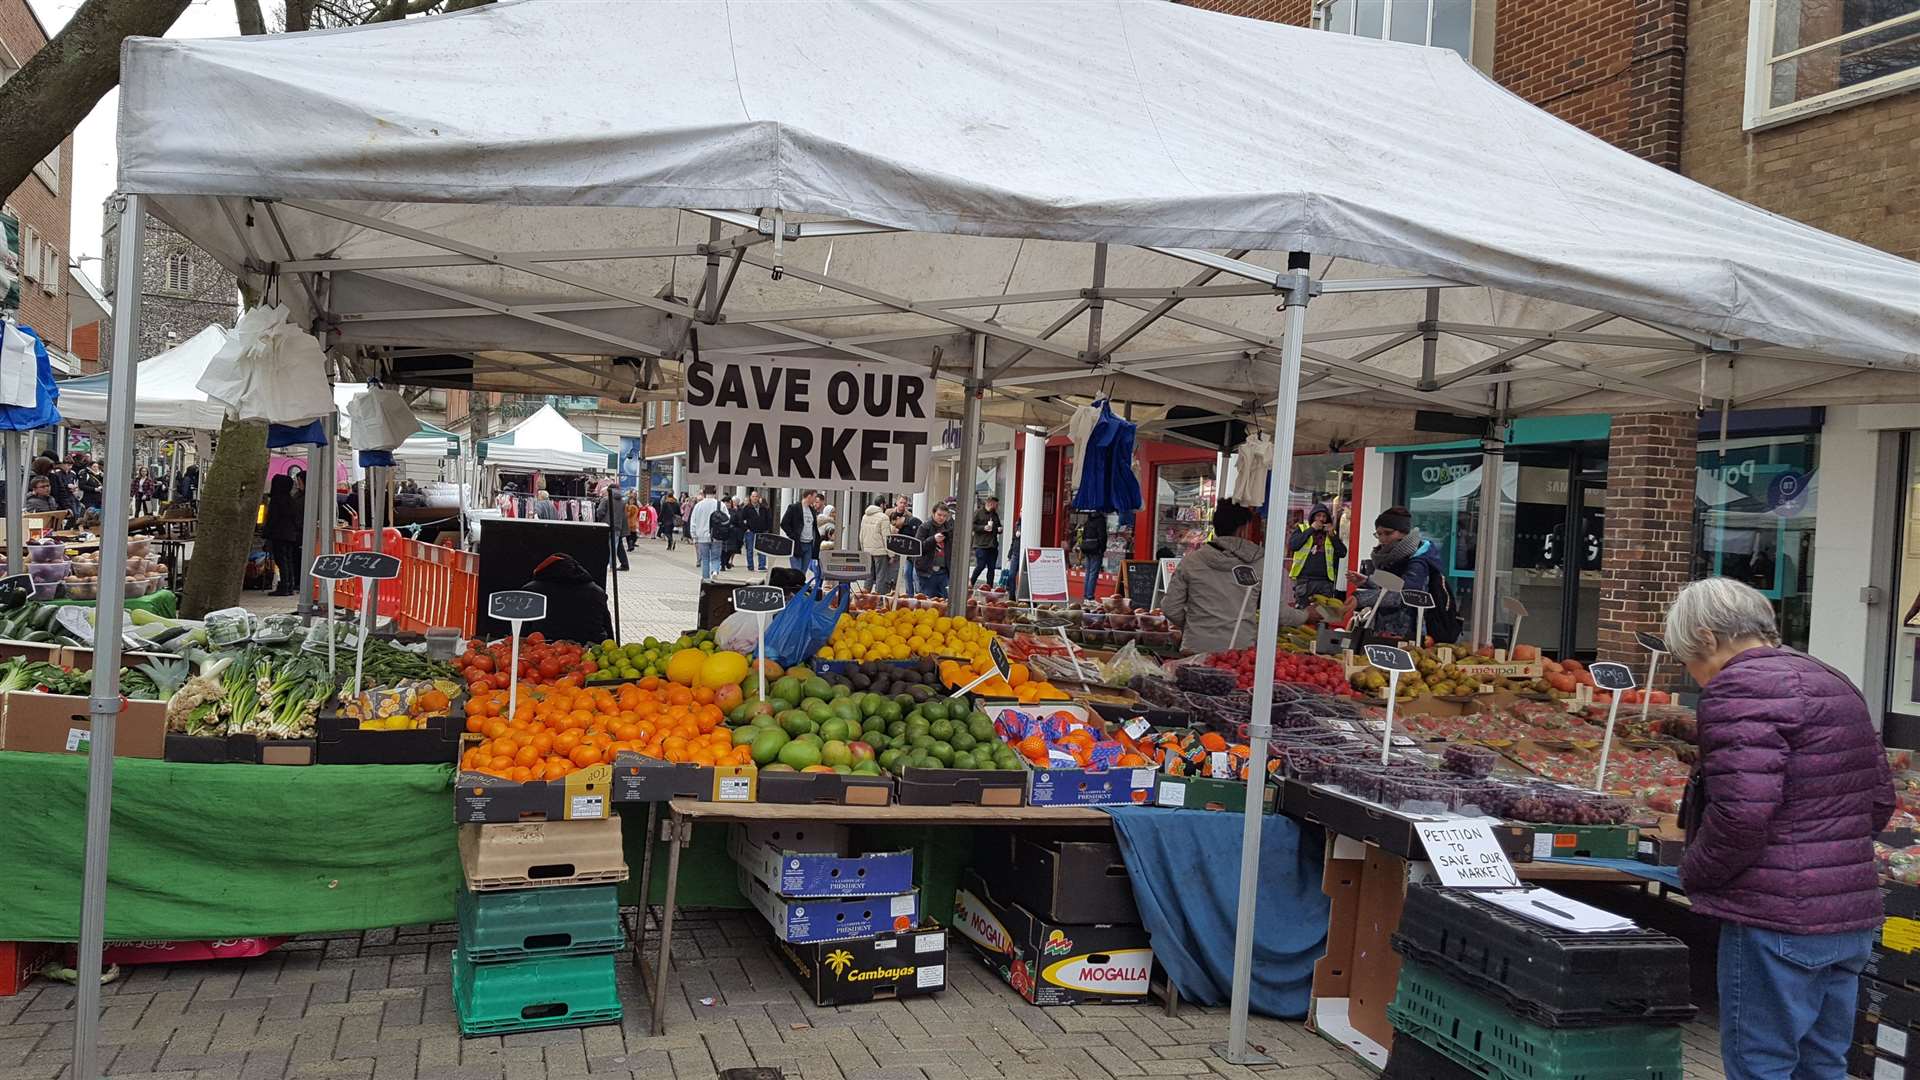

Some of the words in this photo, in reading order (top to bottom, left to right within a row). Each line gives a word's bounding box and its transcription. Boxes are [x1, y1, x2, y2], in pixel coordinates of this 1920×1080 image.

[687, 362, 811, 413] SAVE
[827, 372, 926, 418] OUR
[687, 419, 928, 484] MARKET
[1783, 481, 1794, 489] BT
[495, 596, 506, 612] 5
[1423, 827, 1483, 842] PETITION
[1448, 843, 1465, 852] TO
[1439, 854, 1472, 867] SAVE
[1479, 852, 1503, 864] OUR
[1456, 865, 1501, 880] MARKET
[830, 882, 866, 890] PRESIDENT
[836, 924, 872, 934] PRESIDENT
[971, 913, 1014, 959] MOGALLA
[848, 966, 915, 981] Cambayas
[1079, 967, 1147, 981] MOGALLA
